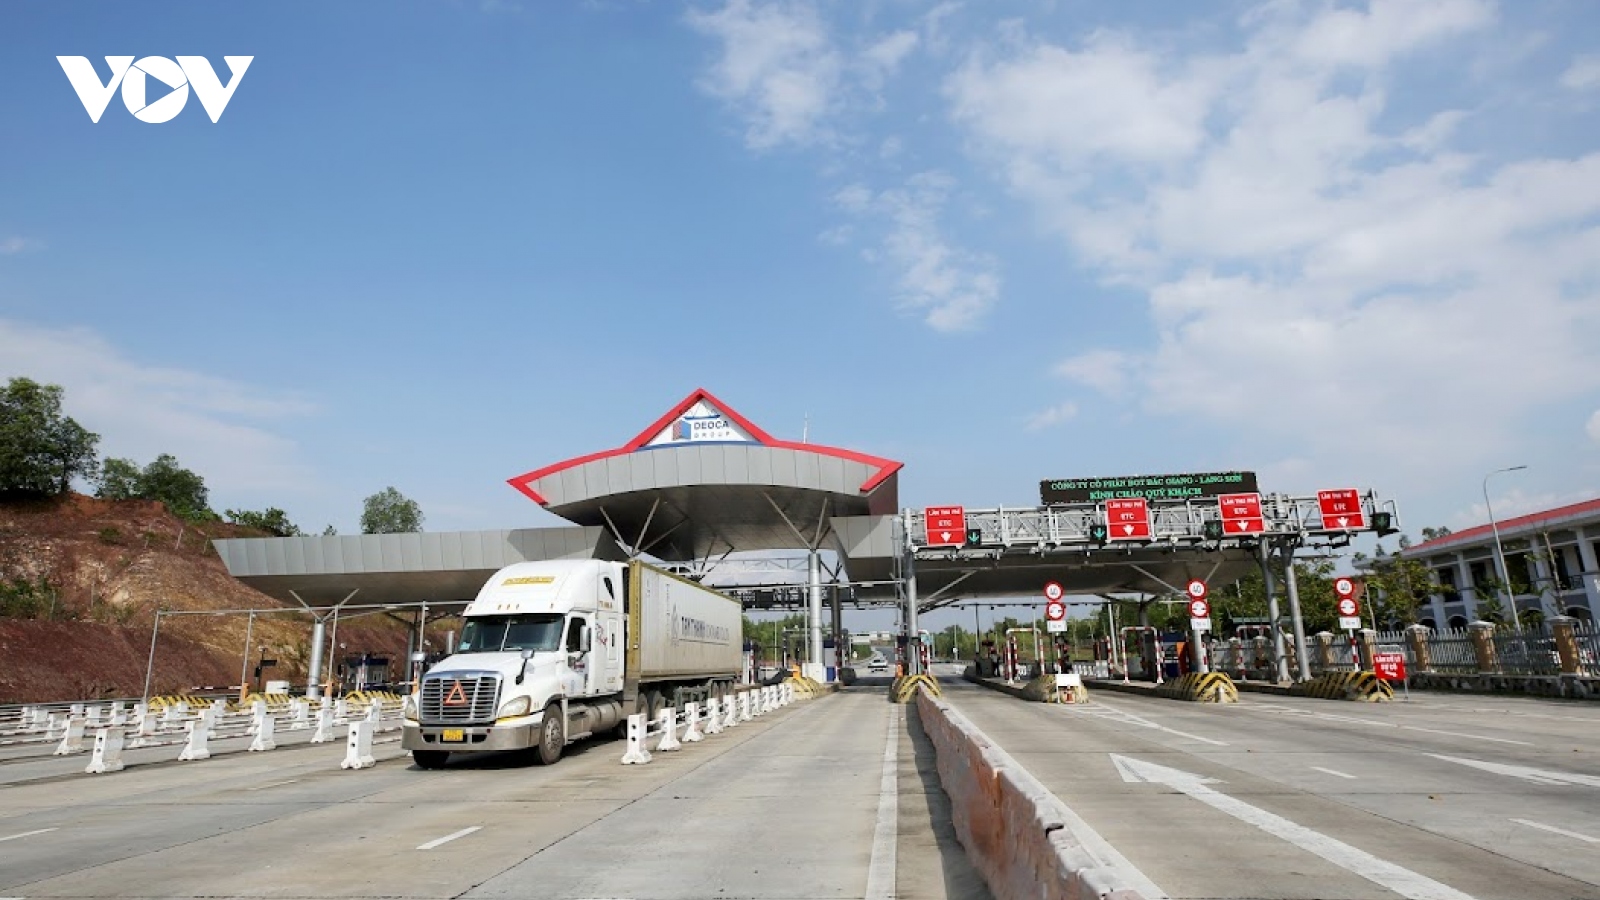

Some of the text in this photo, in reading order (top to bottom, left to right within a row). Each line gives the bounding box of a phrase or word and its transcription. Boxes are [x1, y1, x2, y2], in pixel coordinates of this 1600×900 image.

[694, 420, 729, 430] DEOCA
[1051, 480, 1075, 490] CÔNG
[1078, 481, 1088, 489] TY
[1128, 478, 1145, 487] BOT
[1166, 476, 1193, 485] GIANG
[1090, 486, 1202, 499] KÍNH CHÀO QUÝ KHÁCH
[1193, 585, 1202, 593] 40
[1340, 582, 1350, 591] 40
[1049, 587, 1058, 596] 40
